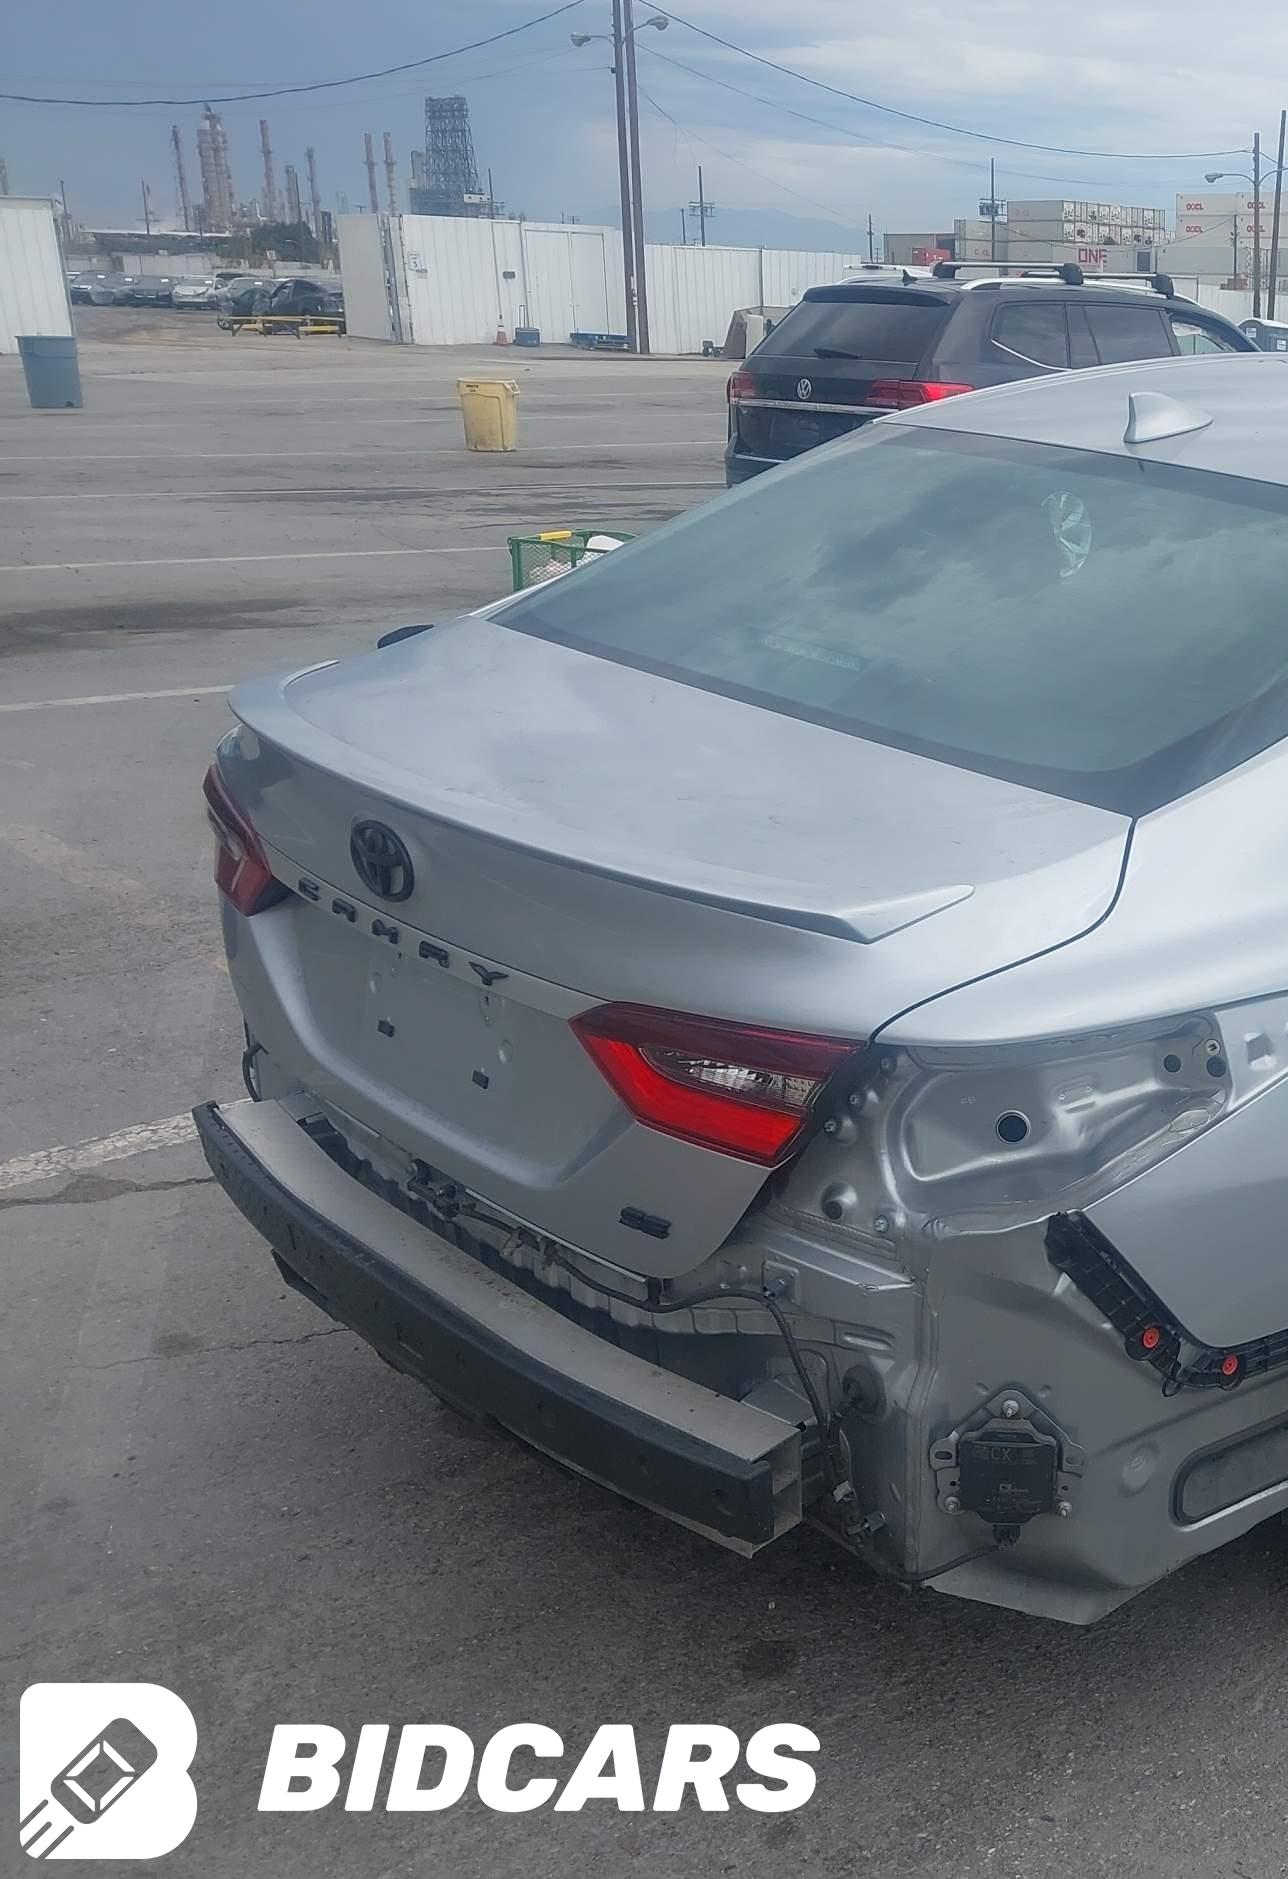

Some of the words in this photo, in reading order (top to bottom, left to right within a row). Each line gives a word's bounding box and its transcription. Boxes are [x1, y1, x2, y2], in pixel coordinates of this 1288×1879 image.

[1185, 203, 1204, 211] OOCL
[1185, 225, 1204, 233] OOCL
[1079, 248, 1107, 263] ONE
[298, 877, 509, 986] CAMRY
